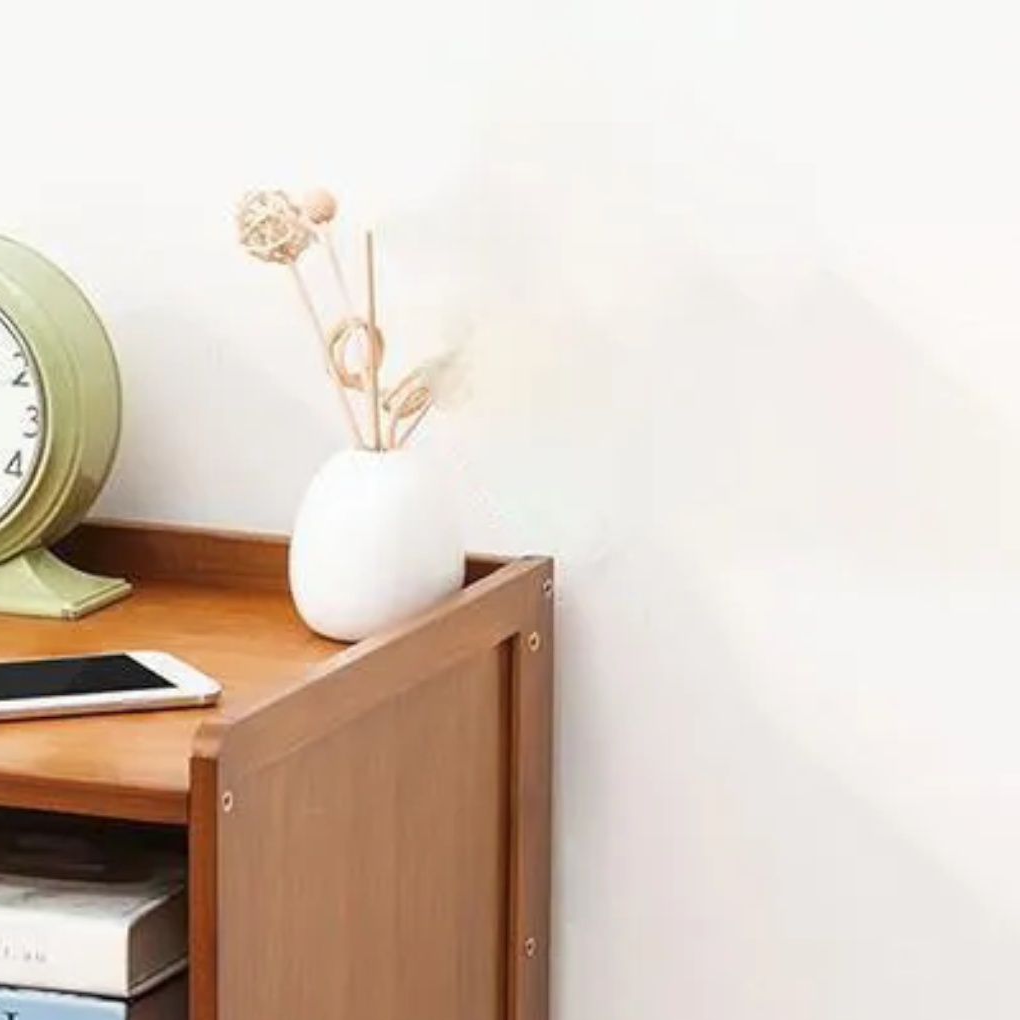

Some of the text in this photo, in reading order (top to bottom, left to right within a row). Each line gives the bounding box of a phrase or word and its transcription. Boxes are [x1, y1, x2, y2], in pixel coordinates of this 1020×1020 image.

[11, 352, 29, 387] 2
[22, 405, 40, 438] 3
[4, 450, 23, 477] 4
